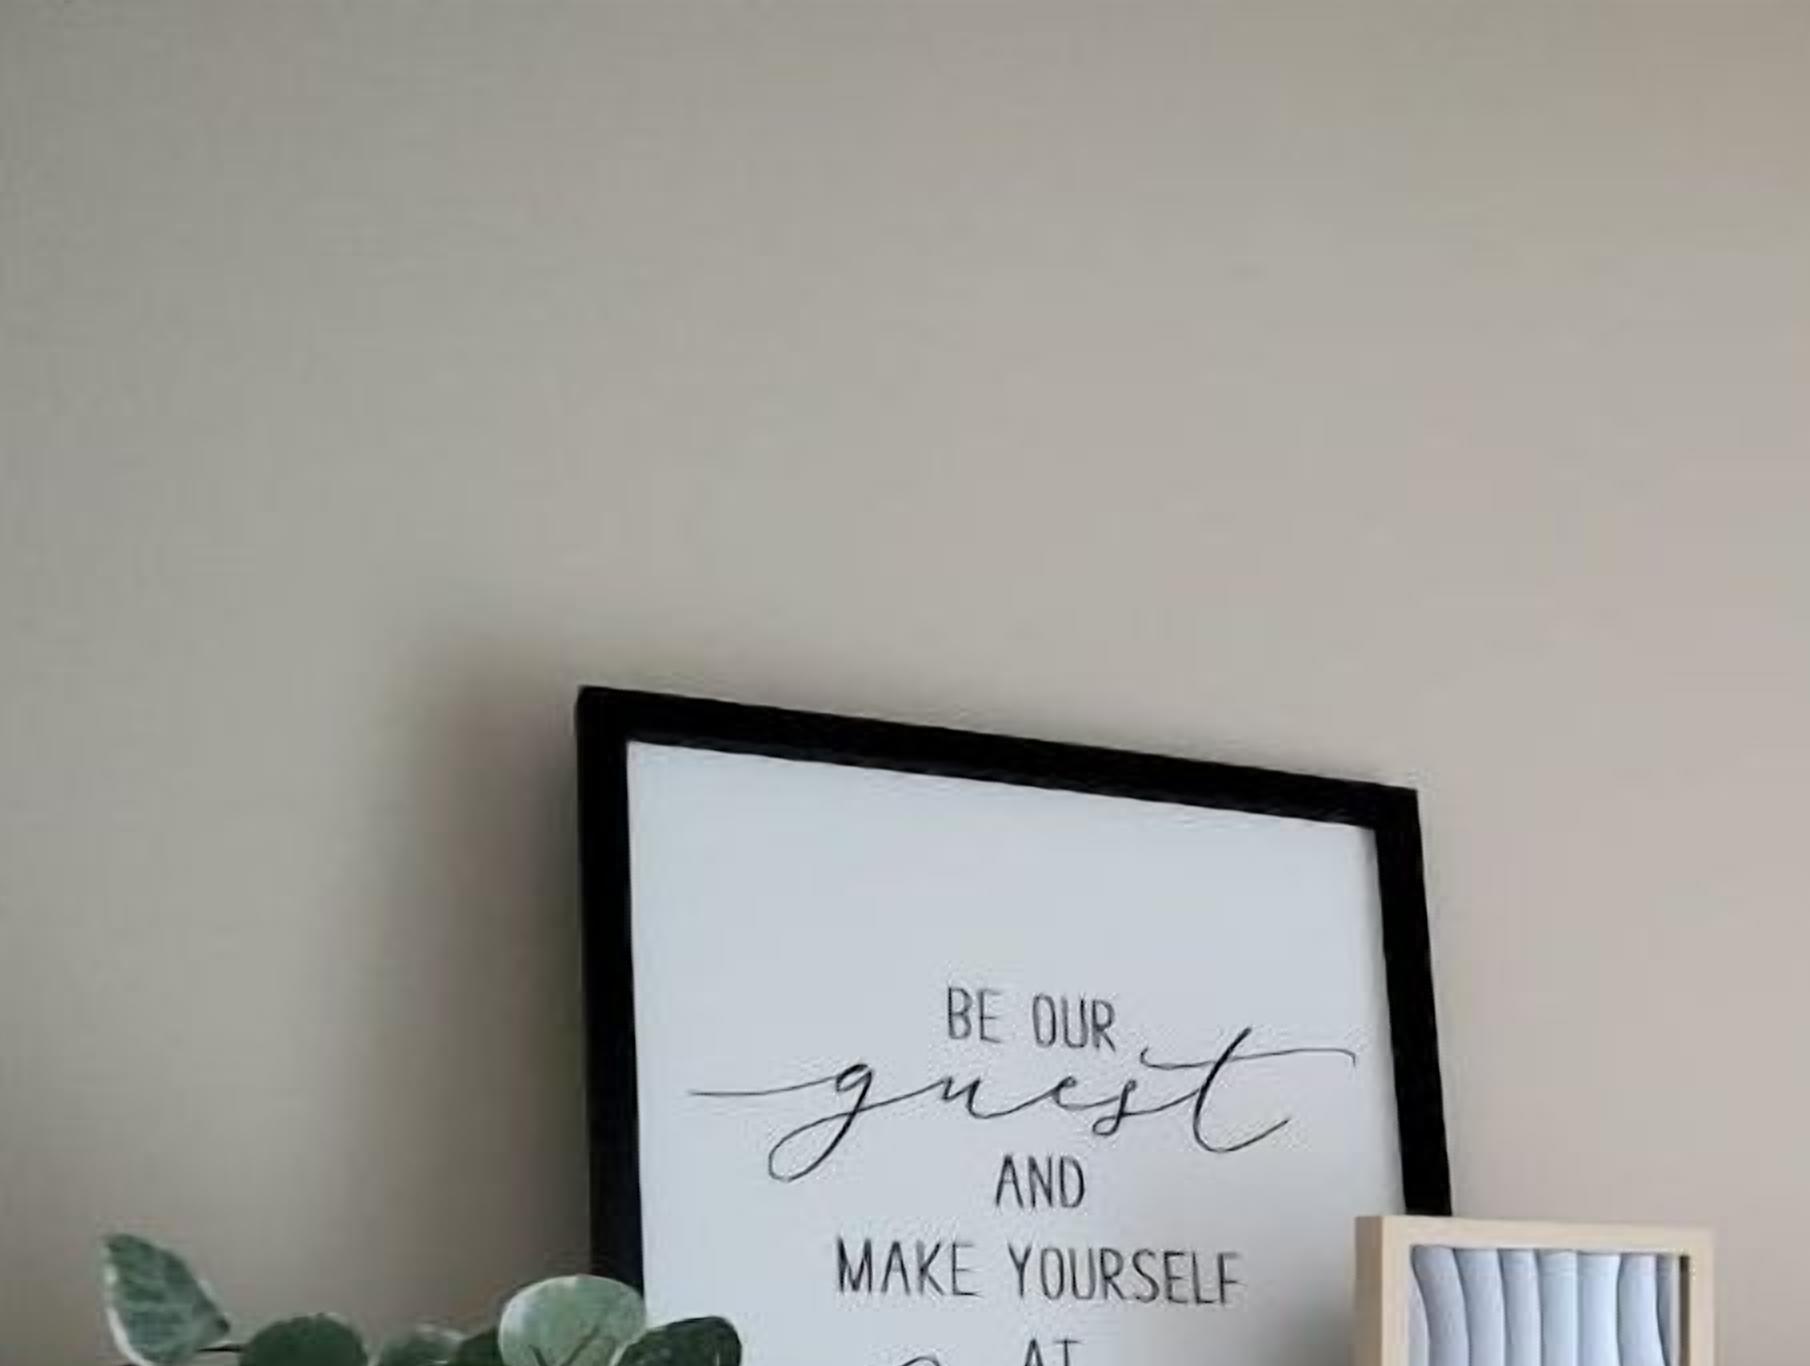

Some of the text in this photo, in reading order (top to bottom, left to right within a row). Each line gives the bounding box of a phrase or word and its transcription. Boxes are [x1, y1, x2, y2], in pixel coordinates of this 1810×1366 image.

[946, 984, 1117, 1053] BE OUR
[687, 1027, 1357, 1182] guest
[992, 1152, 1086, 1209] AND
[834, 1235, 1243, 1306] MAKE YOURSELF
